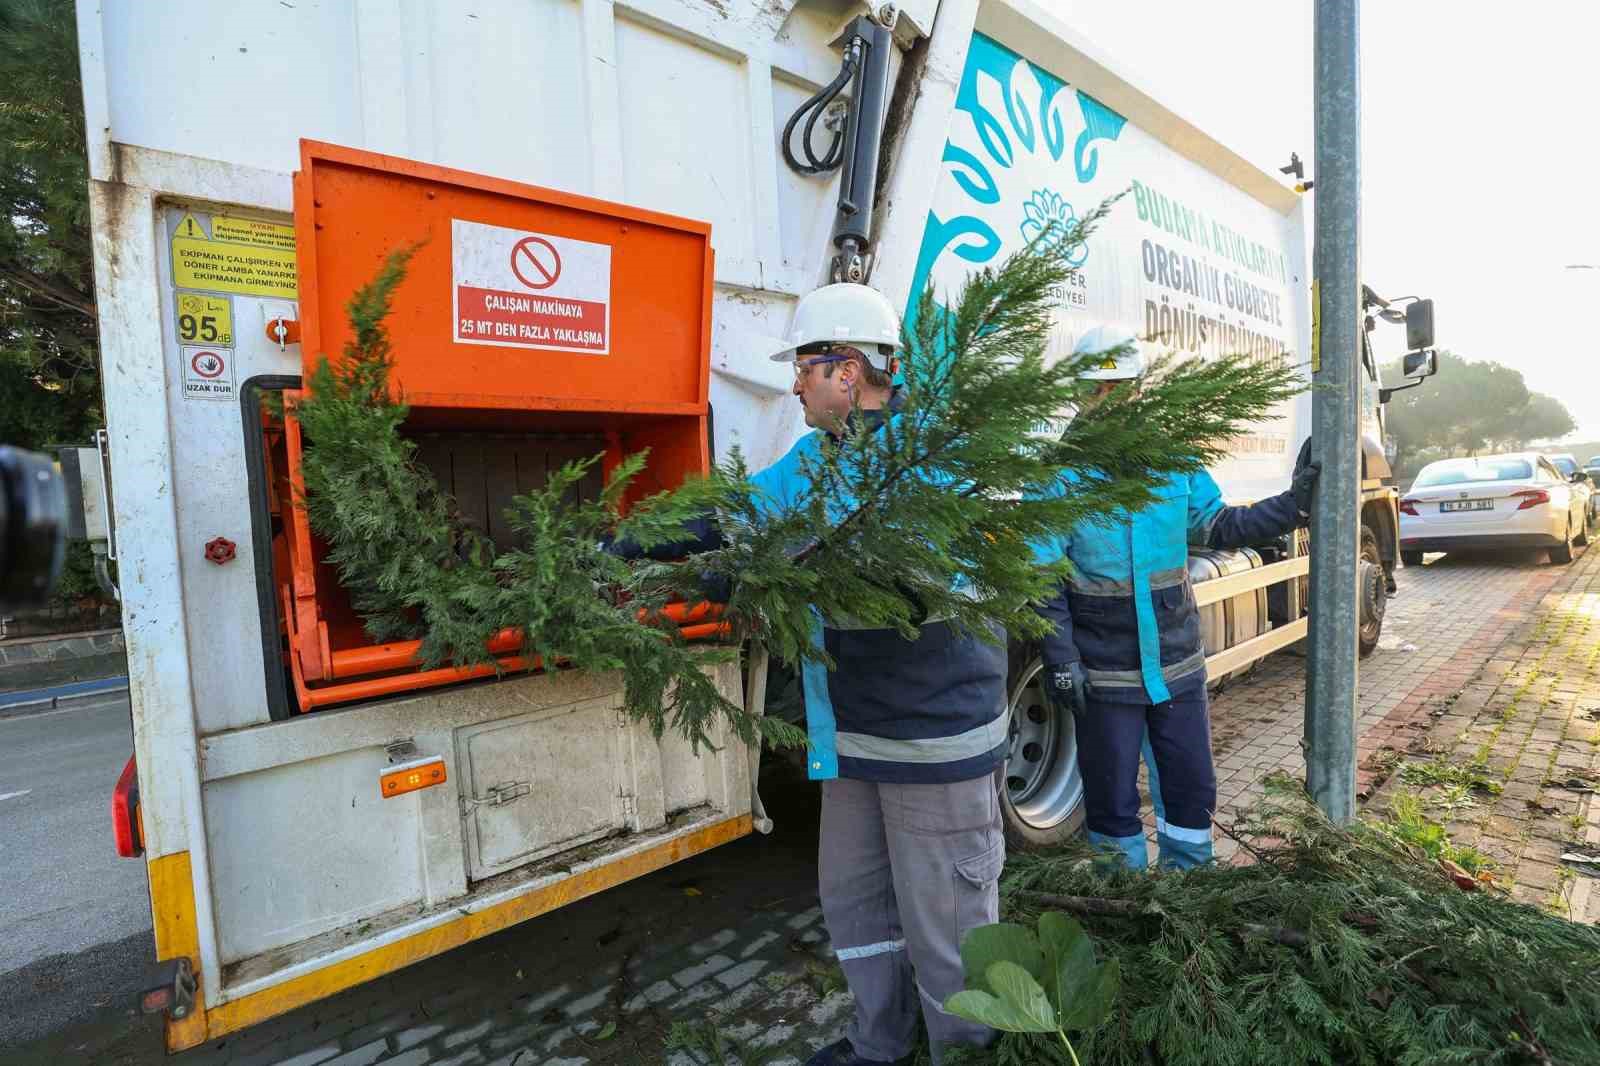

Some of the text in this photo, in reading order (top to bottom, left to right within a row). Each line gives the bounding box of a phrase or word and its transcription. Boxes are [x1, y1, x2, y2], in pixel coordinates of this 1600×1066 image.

[221, 265, 253, 275] LAMBA
[256, 269, 296, 280] YANARKE
[485, 295, 583, 318] ÇALIŞAN MAKİNAYA
[179, 314, 218, 342] 95
[461, 320, 603, 346] 25 MT DEN FAZLA YAKLAŞMA
[186, 384, 212, 392] UZAK
